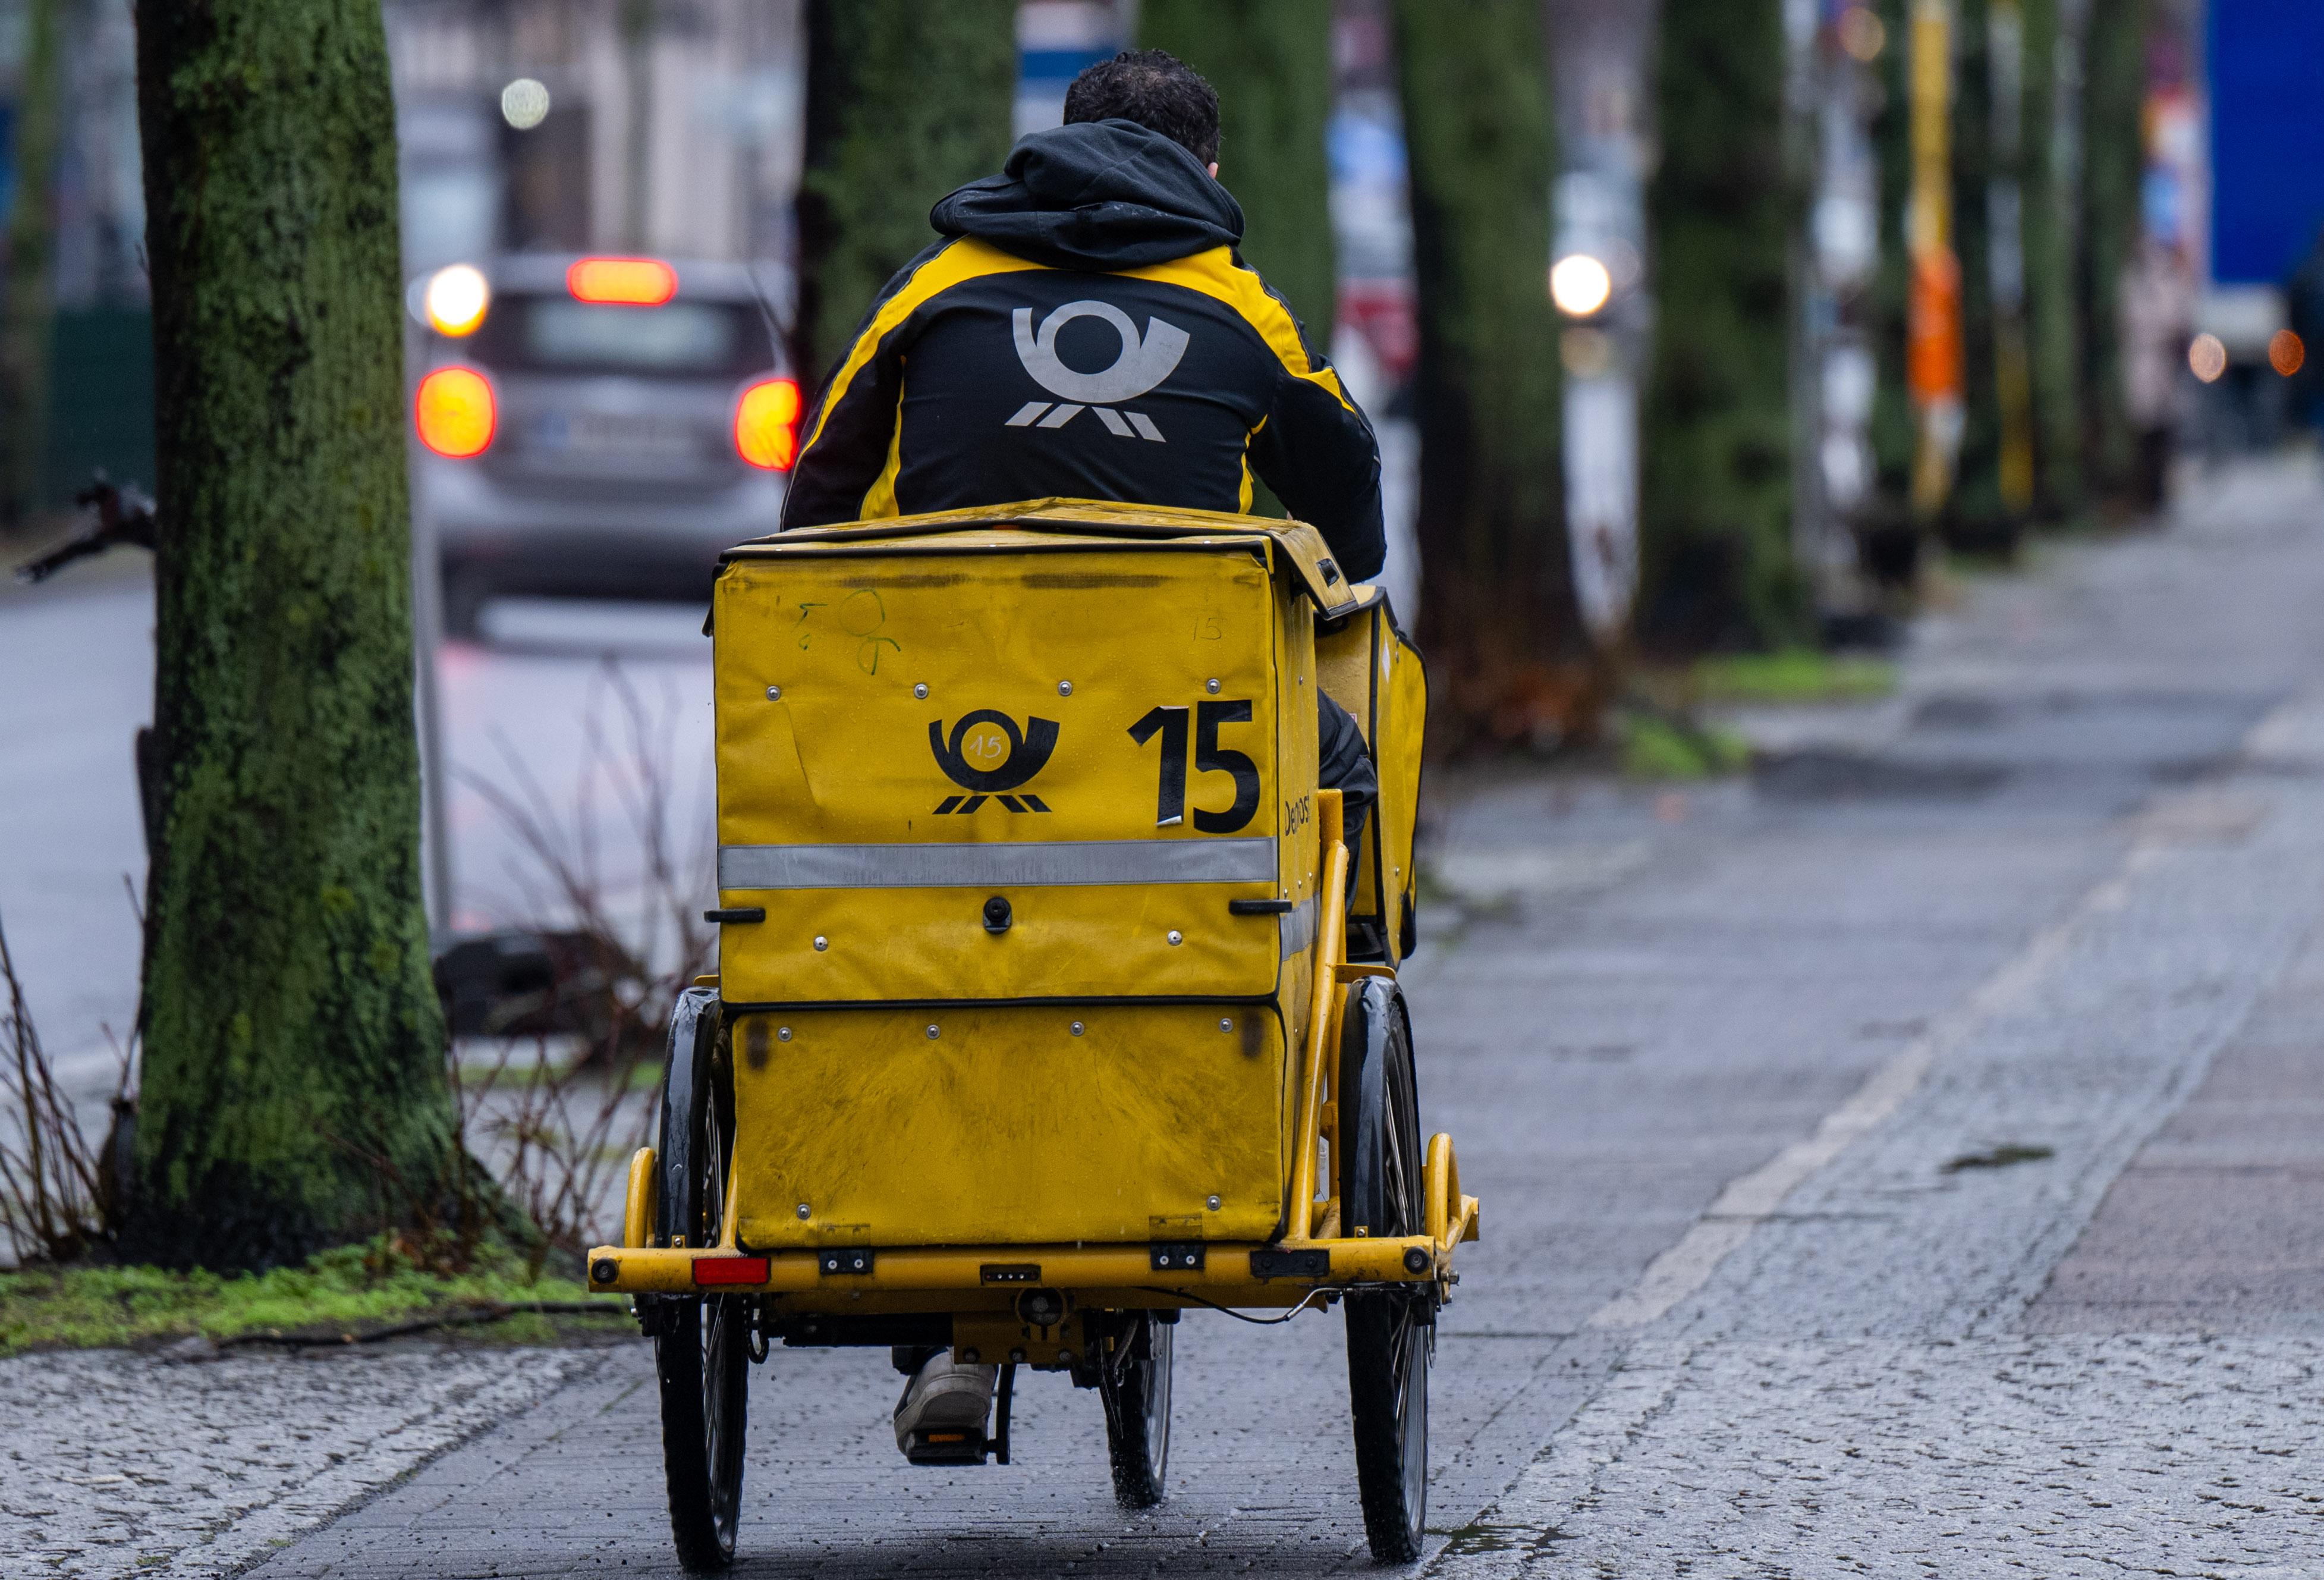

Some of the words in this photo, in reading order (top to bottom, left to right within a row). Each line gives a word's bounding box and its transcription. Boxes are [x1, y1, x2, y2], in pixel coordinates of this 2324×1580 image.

[1193, 616, 1224, 640] 15
[970, 735, 1001, 758] 15
[1127, 699, 1260, 833] 15
